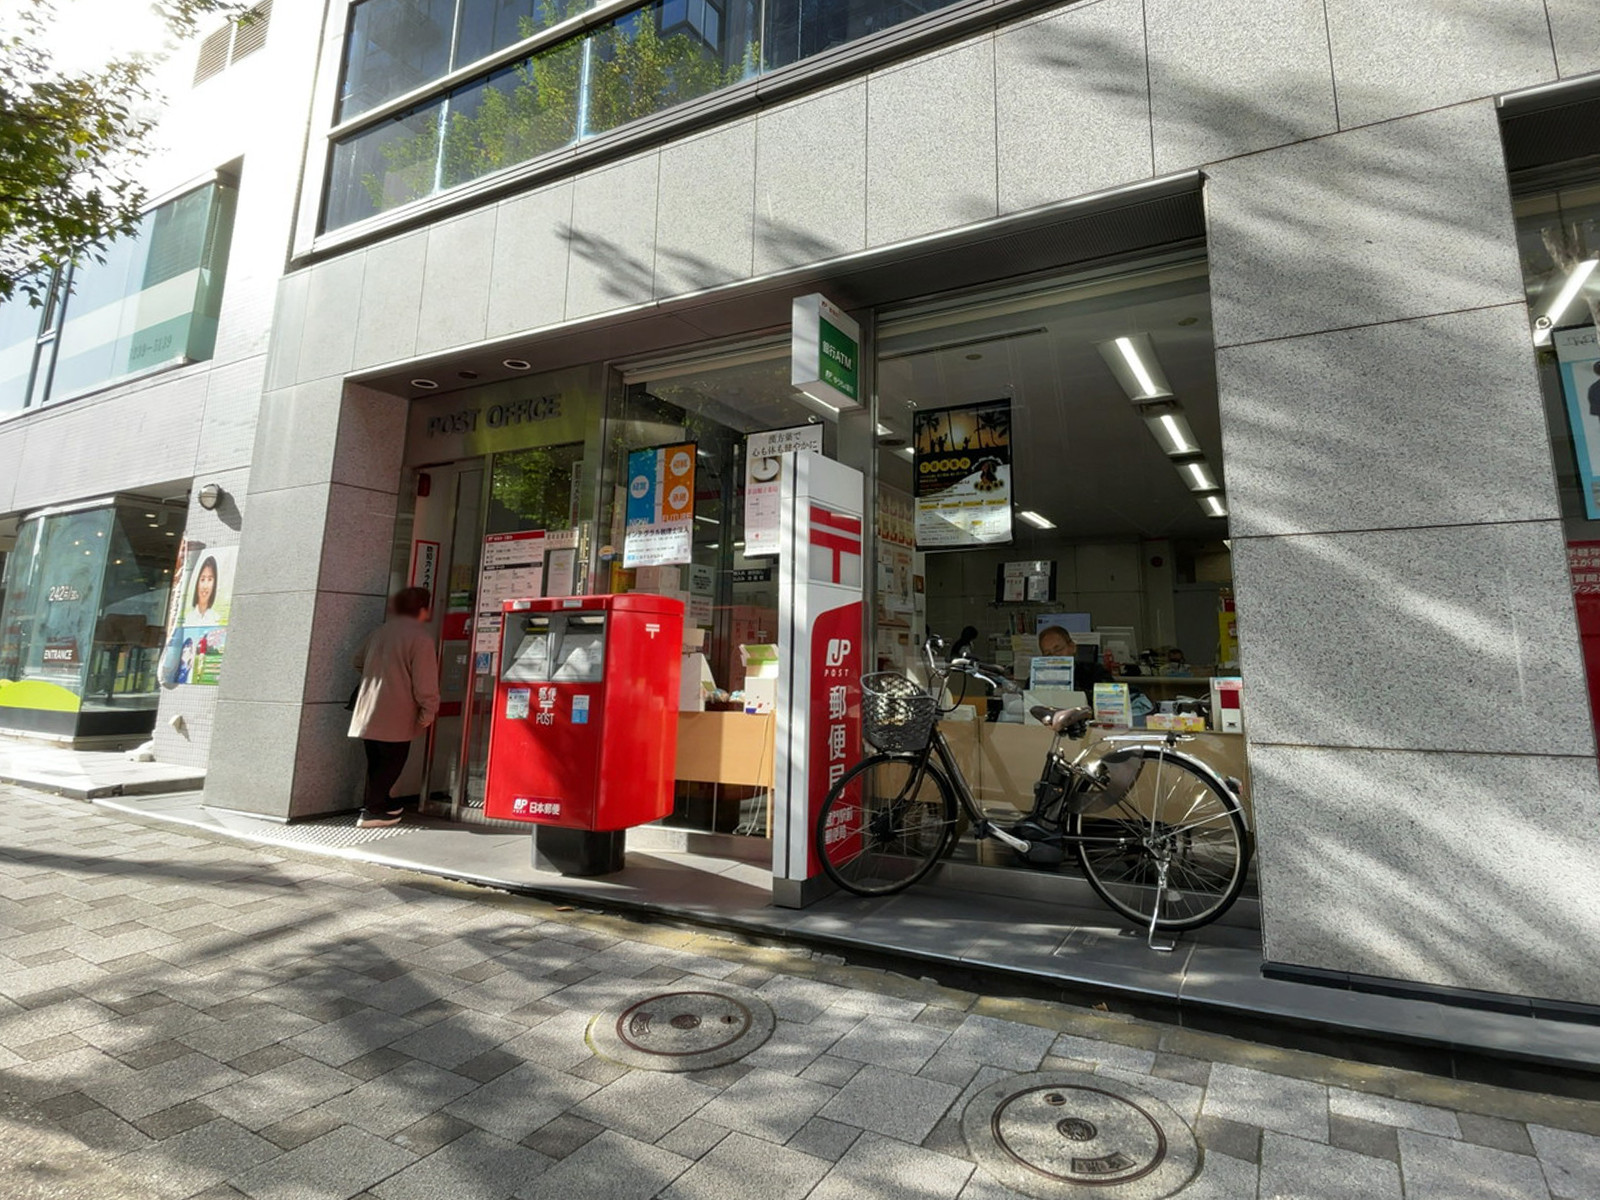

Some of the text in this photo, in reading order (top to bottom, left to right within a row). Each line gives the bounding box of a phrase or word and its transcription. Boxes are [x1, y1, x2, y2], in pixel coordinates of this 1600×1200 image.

[428, 393, 562, 438] POST OFFICE
[768, 432, 801, 445] 漢方薬で
[44, 649, 73, 660] ENTRANCE
[824, 669, 849, 677] POST
[536, 712, 555, 726] POST
[529, 801, 560, 816] 日本郵便
